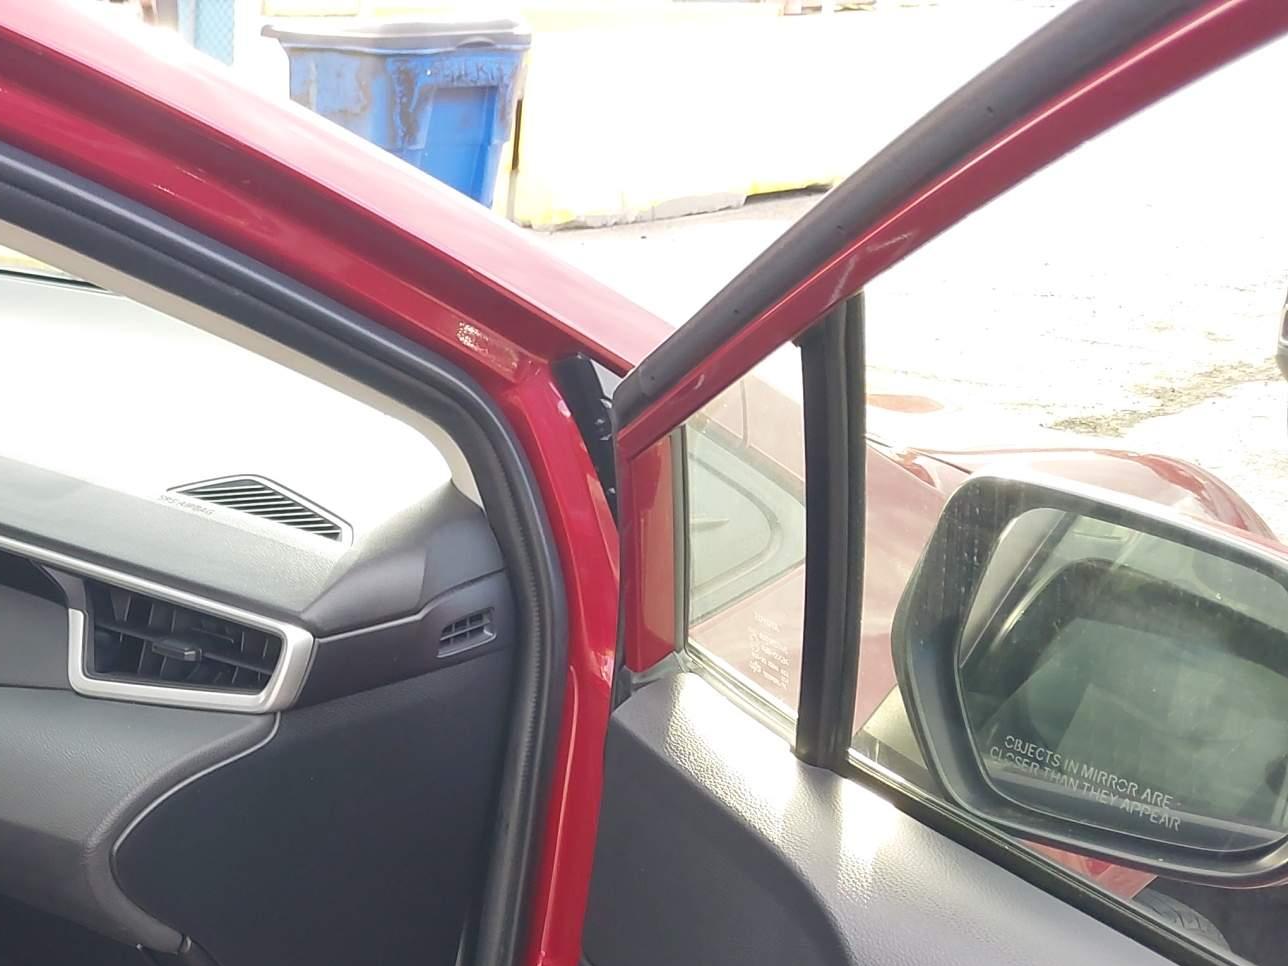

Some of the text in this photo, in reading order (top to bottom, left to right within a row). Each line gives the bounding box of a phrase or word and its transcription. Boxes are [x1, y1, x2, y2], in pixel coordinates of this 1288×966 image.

[990, 745, 1182, 833] CLOSER THAN THEY APPEAR
[1005, 735, 1174, 809] OBJECTS IN MIRROR ARE
